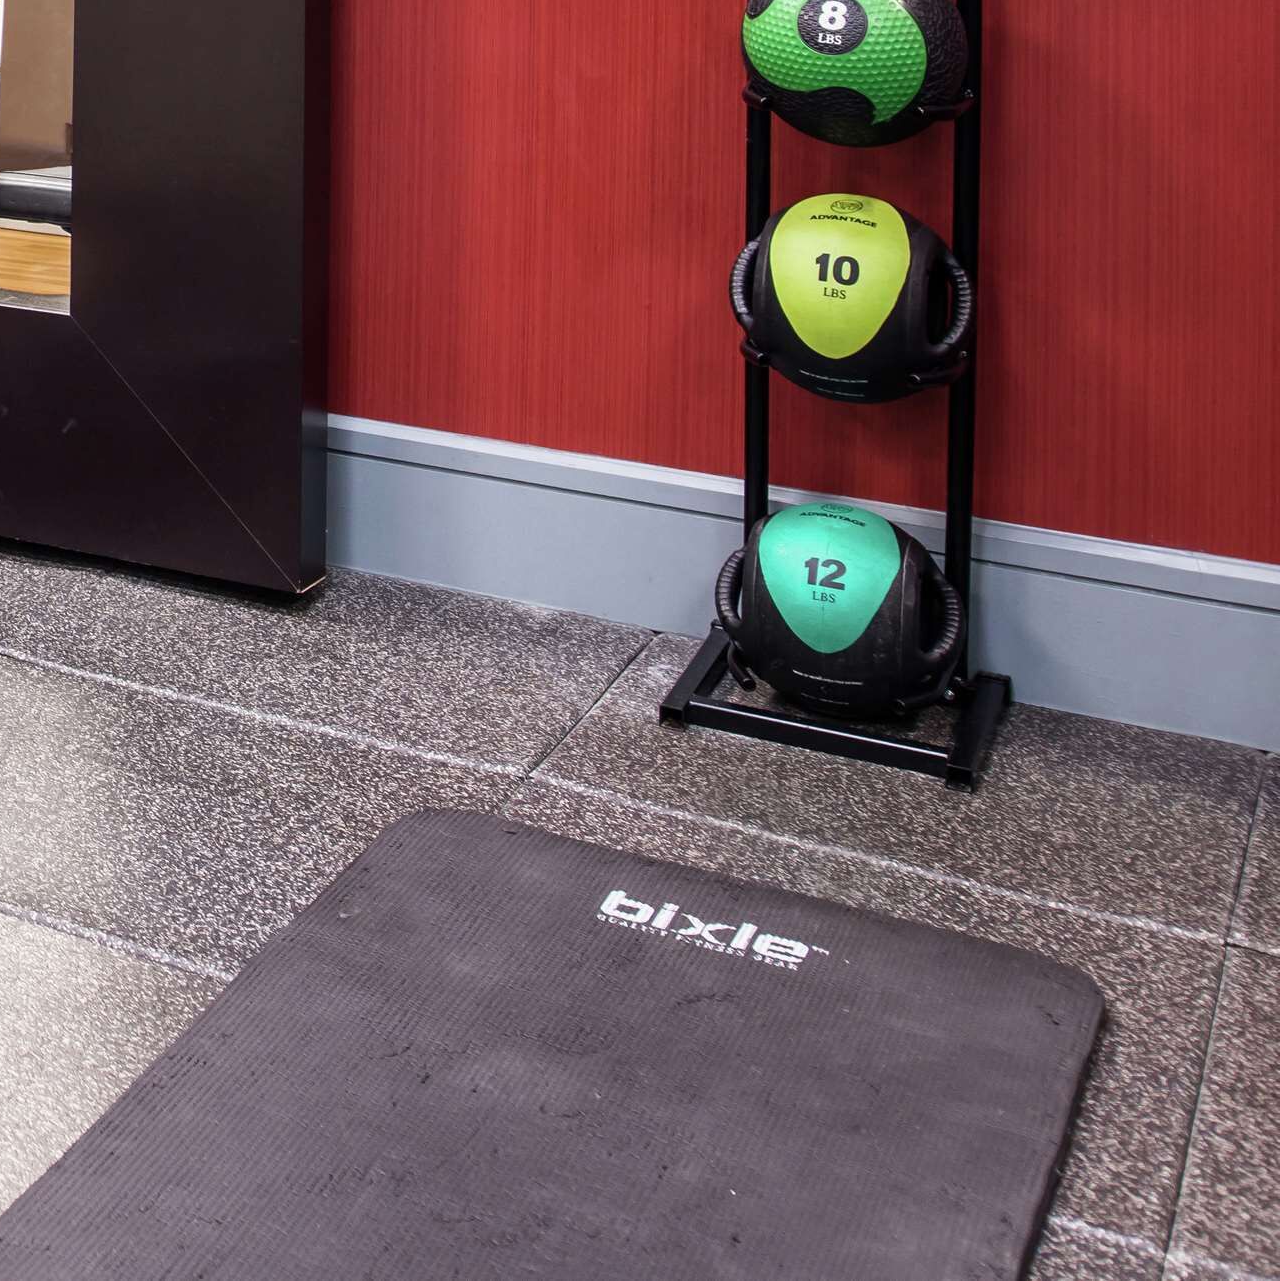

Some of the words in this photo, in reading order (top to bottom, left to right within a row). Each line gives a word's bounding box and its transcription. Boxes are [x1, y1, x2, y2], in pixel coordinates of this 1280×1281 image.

[818, 0, 848, 30] 8
[818, 33, 842, 44] LBS
[810, 214, 878, 228] ADVANTAGE
[815, 253, 860, 286] 10
[823, 287, 847, 300] LBS
[799, 511, 866, 527] ADVANTAGE
[804, 557, 847, 591] 12
[812, 591, 836, 604] LBS
